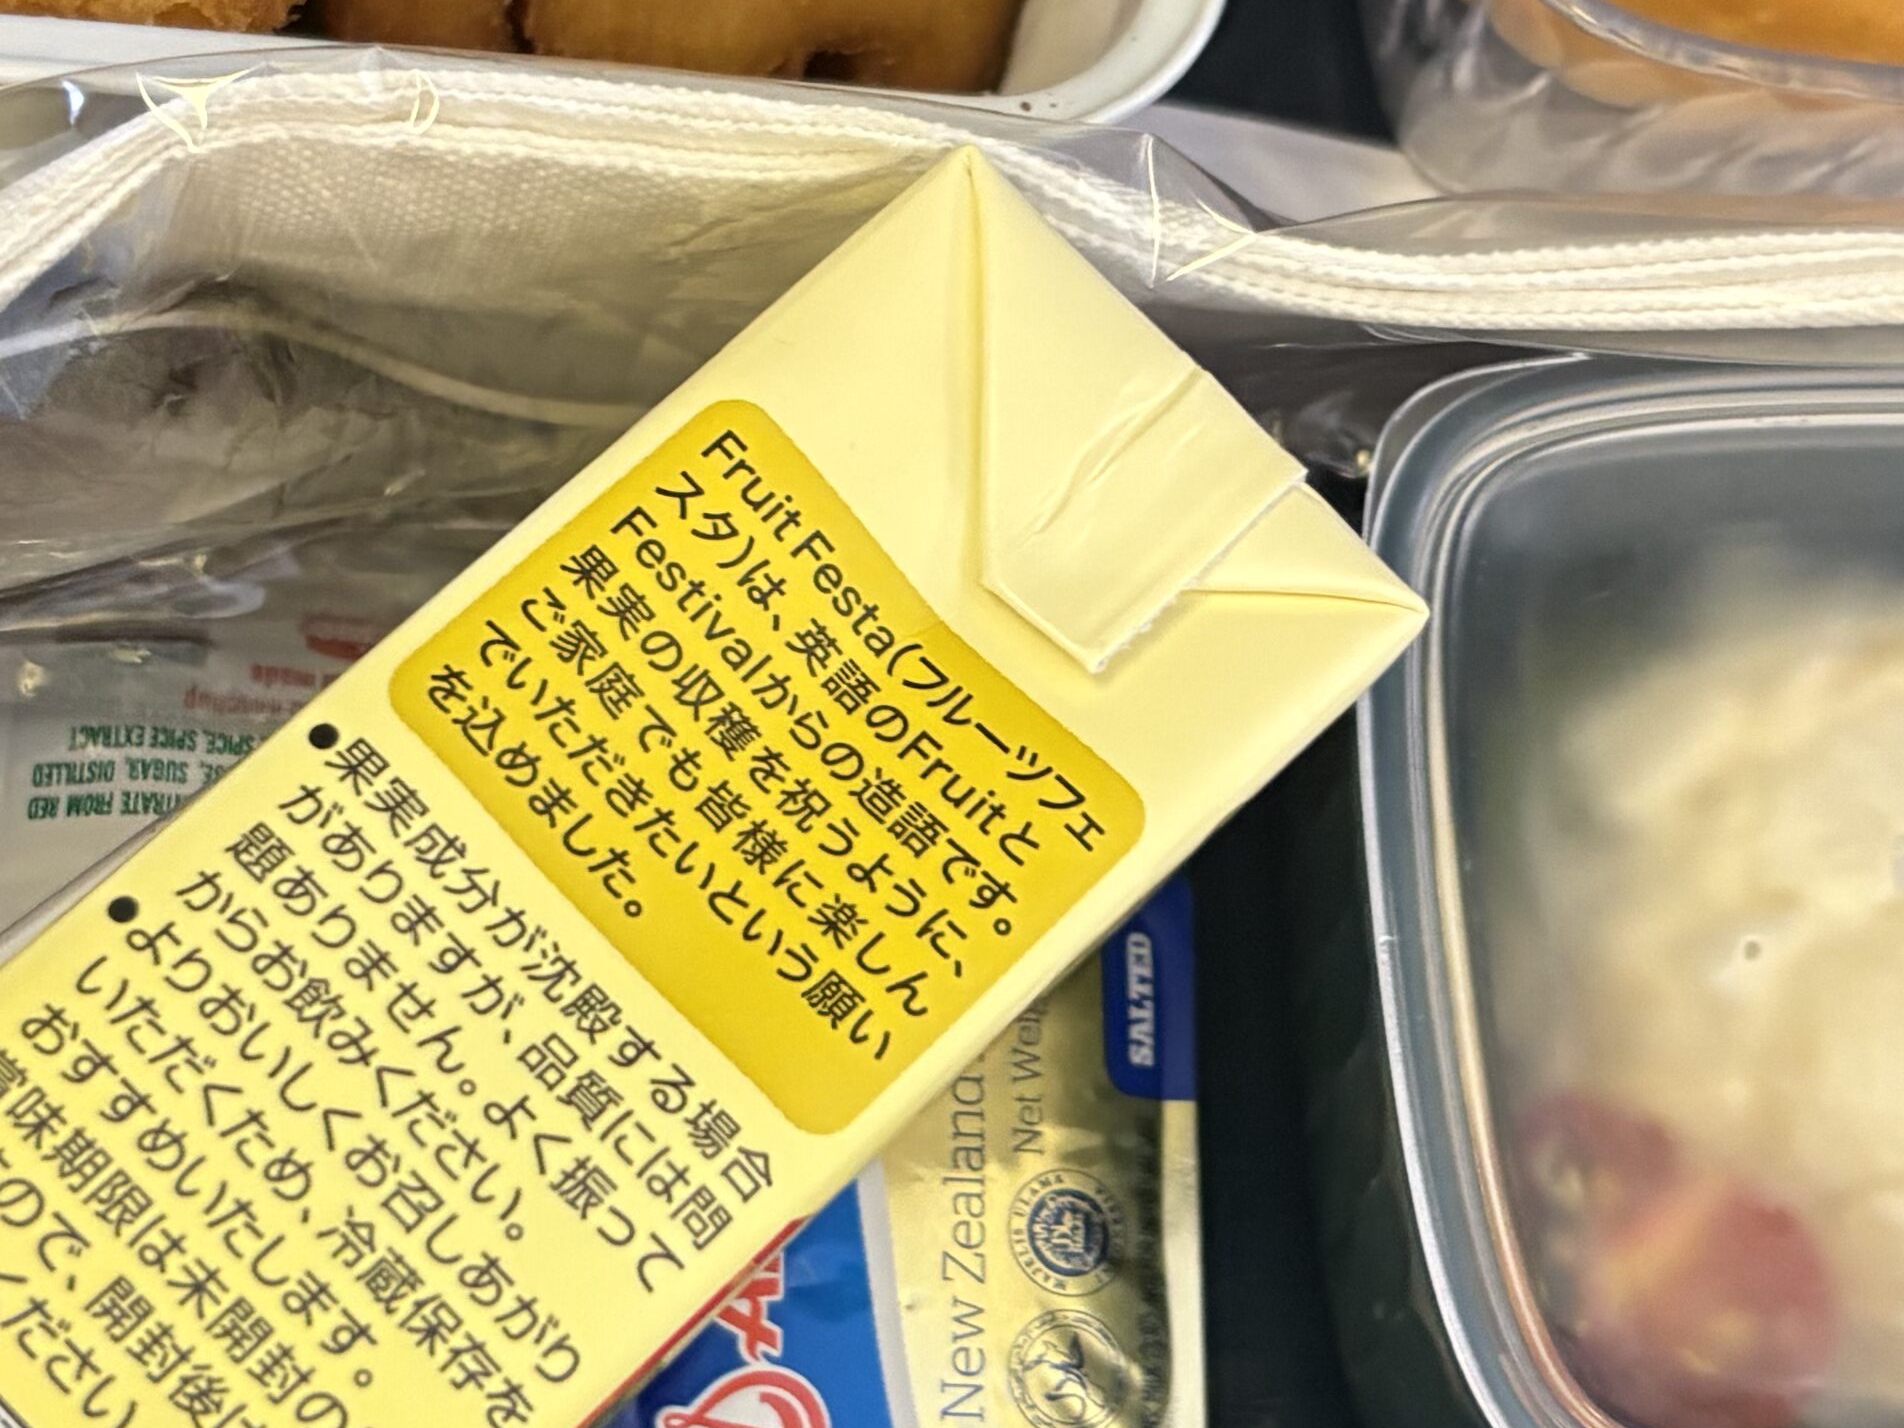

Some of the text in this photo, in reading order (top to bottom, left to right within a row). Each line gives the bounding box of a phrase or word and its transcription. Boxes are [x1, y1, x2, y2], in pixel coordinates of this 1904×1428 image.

[652, 468, 1041, 868] スタ)は、英語のFruitと
[699, 427, 803, 544] Fruit
[27, 796, 60, 820] RED
[31, 759, 116, 788] DISTILLED
[66, 791, 114, 818] FROM
[68, 724, 145, 752] EXTRACT
[150, 726, 197, 753] SPICE
[425, 662, 644, 919] を込めました。
[477, 617, 892, 1062] でいただきたいという願い
[518, 584, 930, 1018] ご家庭でも皆様に楽しん
[557, 542, 969, 979] 果実の収穫を祝うように、
[608, 504, 1019, 937] Festivalからの造語です。
[123, 919, 581, 1384] よりおいしくお召しあがり
[173, 869, 524, 1242] からお飲みください。
[222, 820, 685, 1294] 題ありません。よく振って
[276, 783, 734, 1252] がありますが、品質には問
[321, 735, 774, 1204] 果実成分が沈殿する場合
[1010, 1094, 1045, 1156] Net
[1125, 933, 1156, 1068] SALTED
[19, 1002, 378, 1389] おすすめいたします。
[939, 1074, 988, 1423] New Zealand
